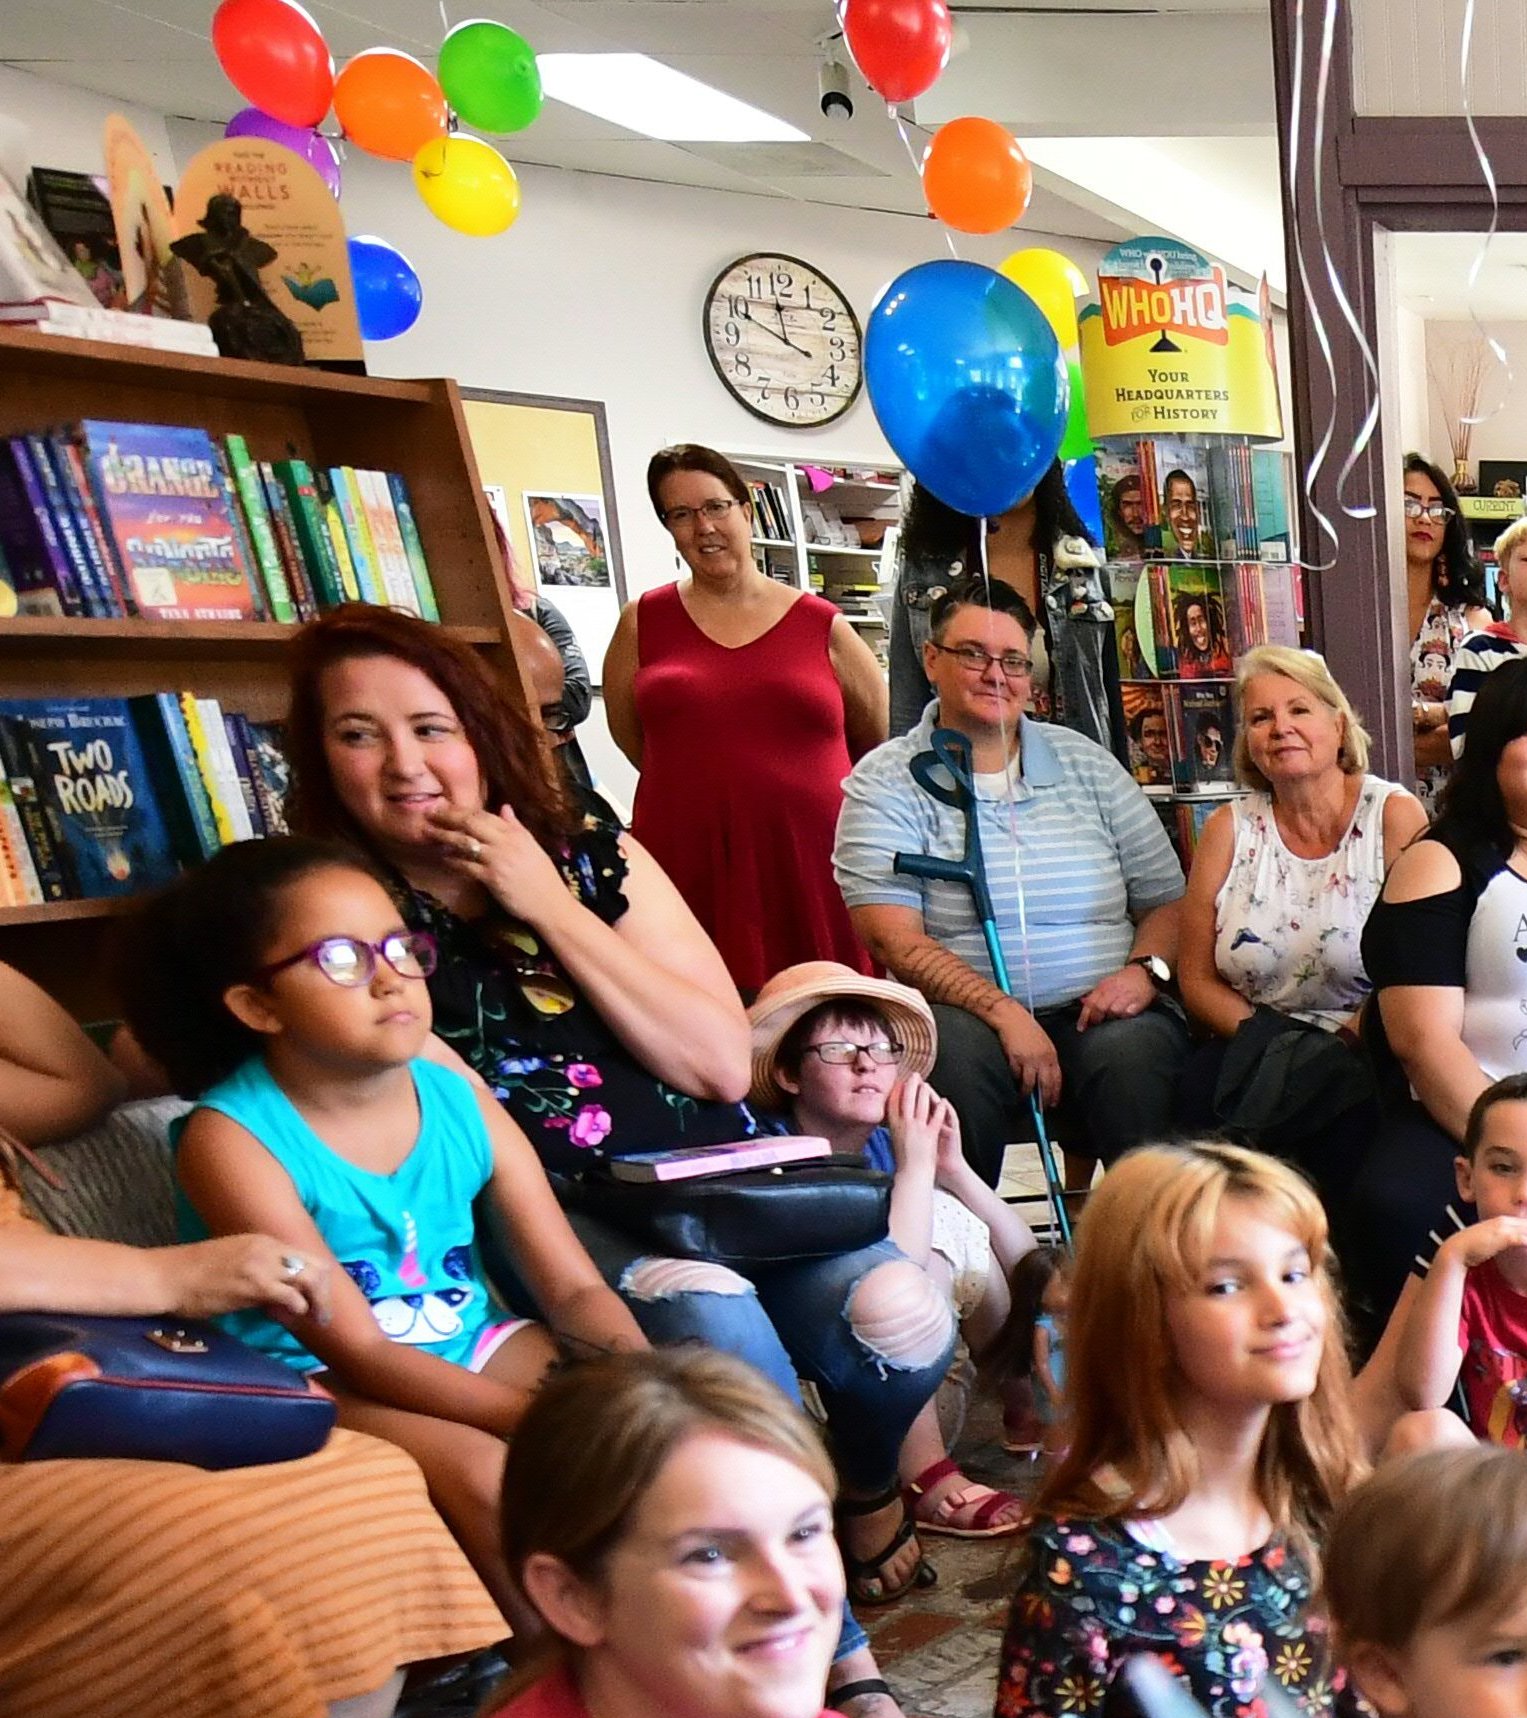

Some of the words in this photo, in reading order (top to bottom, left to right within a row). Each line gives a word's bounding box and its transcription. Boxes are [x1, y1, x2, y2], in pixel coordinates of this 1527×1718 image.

[213, 163, 288, 175] READING
[217, 185, 290, 200] WALLS
[747, 274, 762, 300] 11
[769, 272, 793, 298] 12
[803, 284, 811, 309] 1
[727, 294, 749, 320] 10
[820, 307, 836, 331] 2
[1102, 283, 1227, 331] WHOHQ
[724, 322, 740, 346] 9
[829, 336, 846, 362] 3
[734, 352, 751, 377] 8
[821, 364, 841, 387] 4
[757, 376, 772, 400] 7
[784, 386, 799, 410] 6
[809, 382, 826, 407] 5
[103, 450, 218, 498] ORANGE
[1473, 499, 1516, 512] CURRENT
[47, 739, 113, 776] TWO
[54, 770, 133, 814] ROADS
